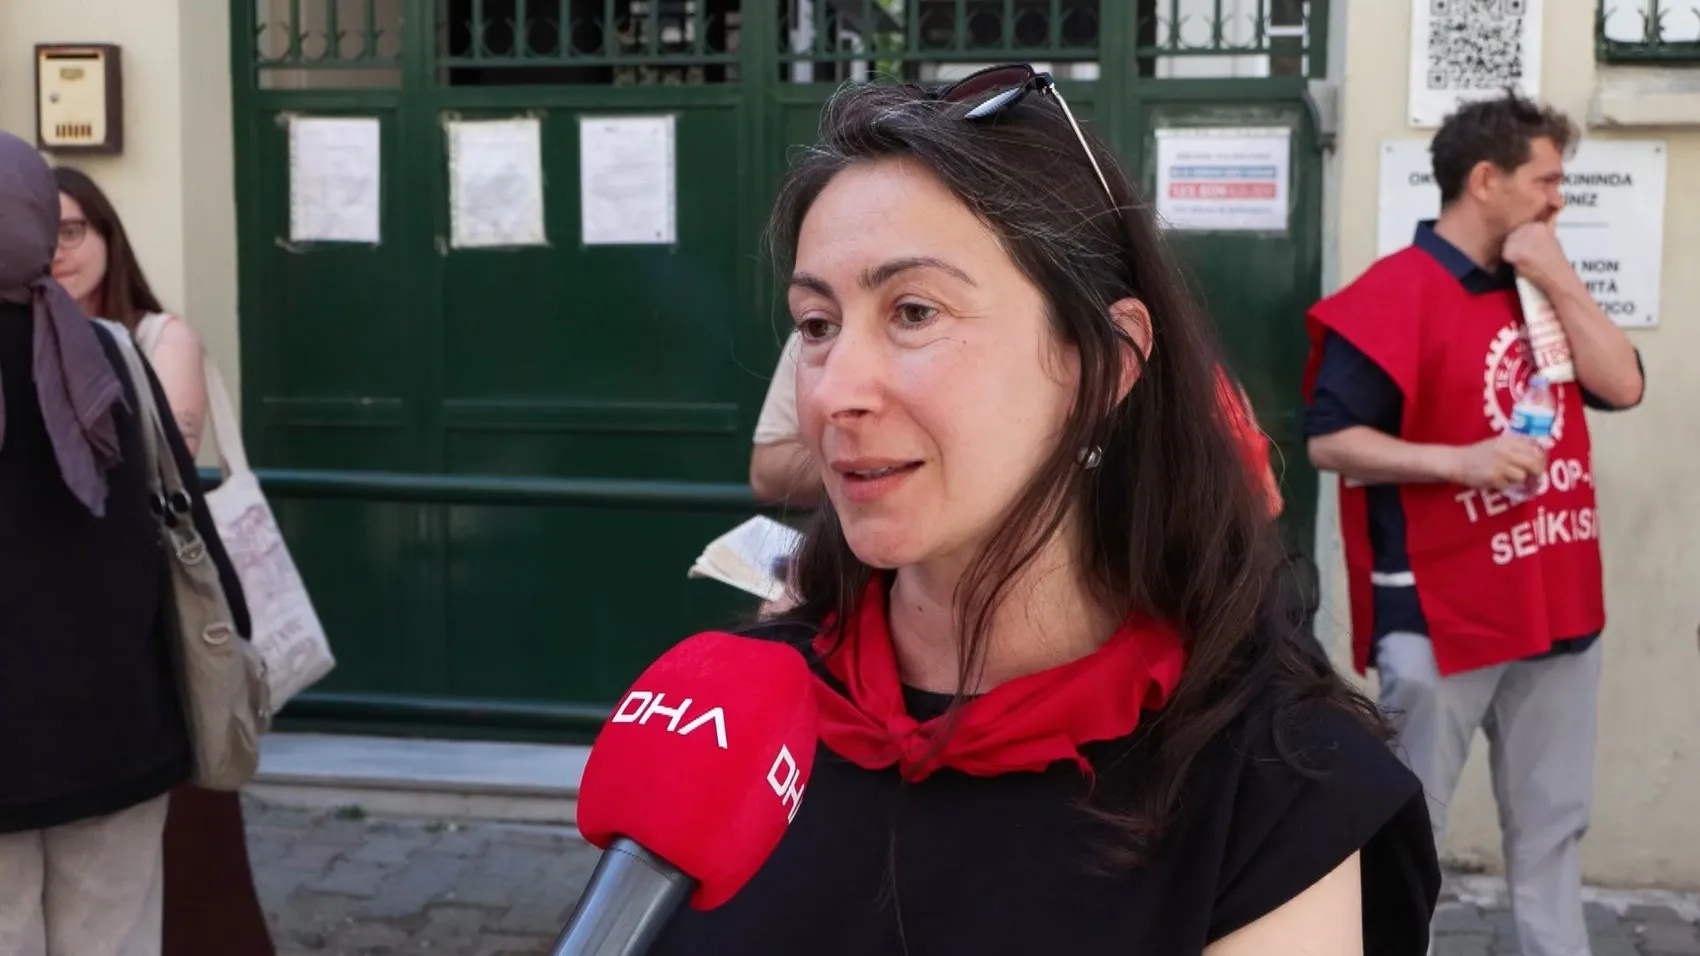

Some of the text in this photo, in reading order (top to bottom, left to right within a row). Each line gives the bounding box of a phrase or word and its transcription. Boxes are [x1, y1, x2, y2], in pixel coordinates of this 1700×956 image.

[1582, 260, 1620, 273] NON
[612, 691, 728, 749] DHA
[766, 743, 805, 825] DH
